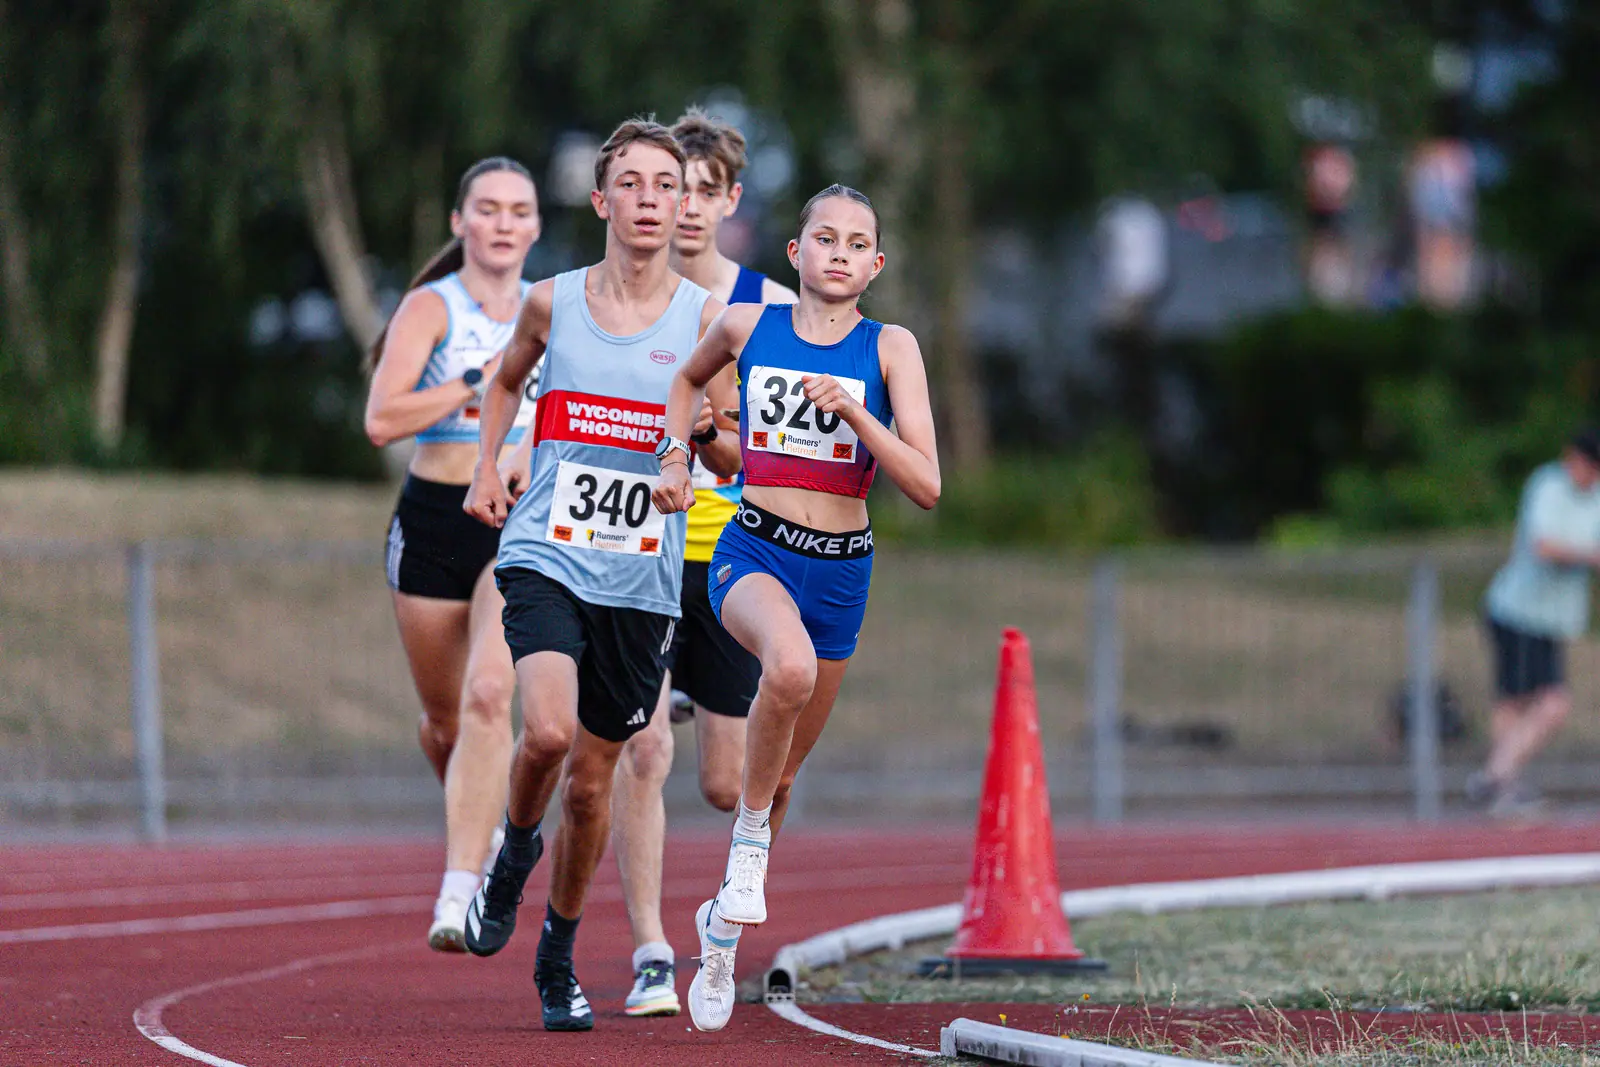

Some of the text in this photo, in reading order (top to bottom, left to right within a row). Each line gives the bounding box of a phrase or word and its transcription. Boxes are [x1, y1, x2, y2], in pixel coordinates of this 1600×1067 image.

[652, 353, 675, 364] wasp
[566, 400, 666, 429] WYCOMBE
[569, 418, 660, 444] PHOENIX
[787, 434, 821, 448] Runners'
[785, 443, 817, 457] Retreat
[569, 473, 652, 529] 340
[596, 531, 629, 542] Runners'
[772, 523, 845, 555] NIKE
[847, 530, 874, 555] PR
